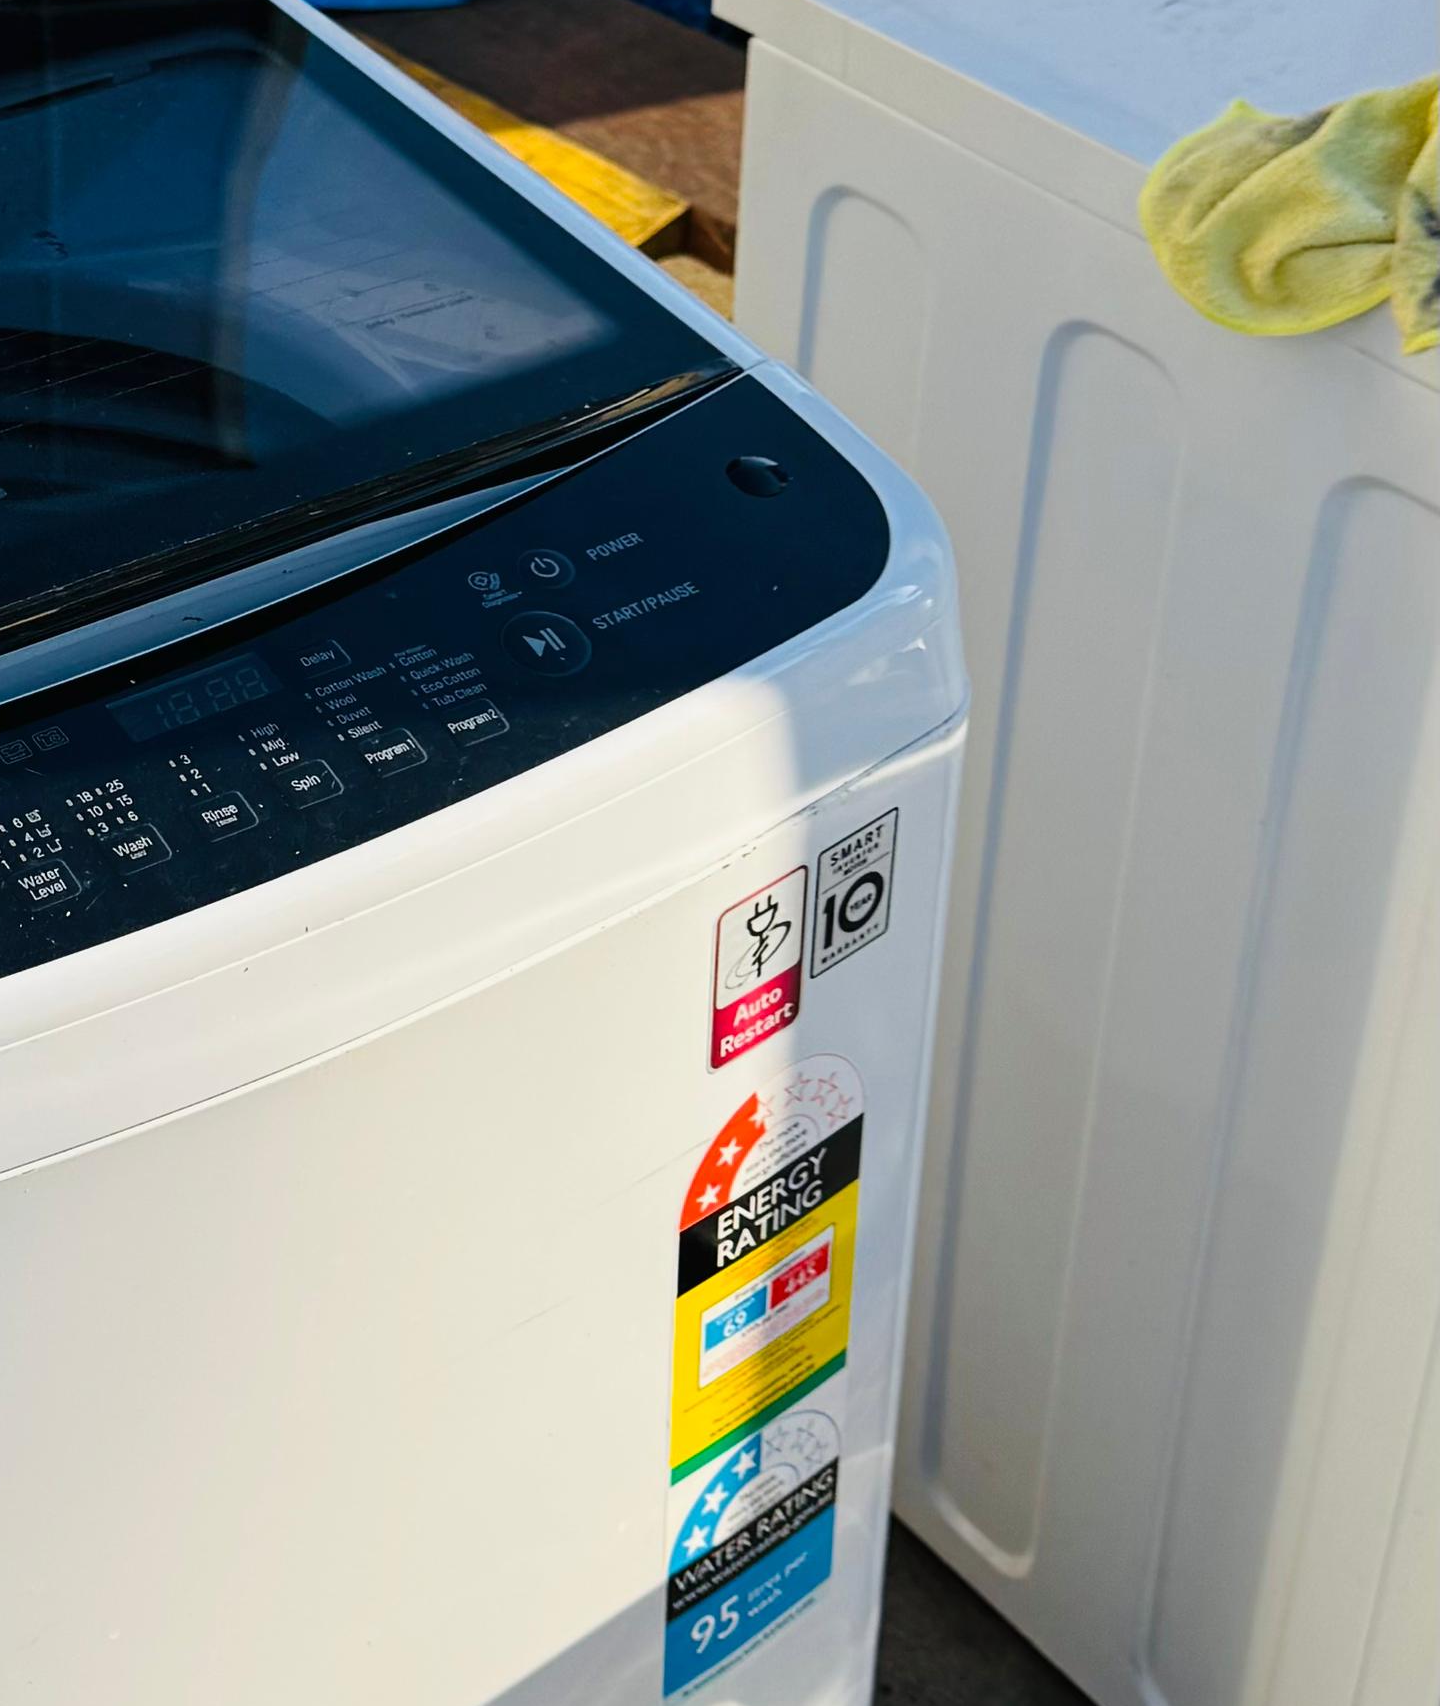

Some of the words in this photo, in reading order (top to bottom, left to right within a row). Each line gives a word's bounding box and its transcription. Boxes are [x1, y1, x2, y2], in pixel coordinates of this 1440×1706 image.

[586, 532, 644, 561] POWER
[592, 581, 700, 630] START/PAUSE
[299, 649, 336, 668] Delay
[398, 647, 438, 667] Cotton
[410, 664, 442, 681] Quick
[441, 651, 475, 669] Wash
[315, 676, 354, 698] Cotton
[354, 665, 388, 684] Wash
[420, 680, 444, 695] Eco
[443, 666, 481, 687] Cotton
[324, 693, 358, 711] Wool
[431, 693, 456, 708] Tub
[454, 681, 488, 699] Clean
[336, 706, 372, 725] Duvet
[447, 710, 490, 735] Program
[487, 708, 499, 720] 2
[249, 721, 280, 739] High
[347, 720, 384, 740] Silent
[179, 754, 192, 765] 3
[271, 751, 300, 768] Low
[364, 742, 408, 765] Program
[189, 768, 203, 780] 2
[290, 773, 321, 792] Spin
[76, 791, 94, 804] 18
[105, 778, 125, 794] 25
[201, 782, 212, 793] 1
[87, 804, 104, 819] 10
[116, 793, 134, 807] 15
[201, 804, 239, 825] Rinse
[12, 817, 24, 829] 6
[97, 821, 110, 833] 3
[127, 810, 139, 822] 6
[24, 831, 35, 843] 4
[112, 835, 154, 858] Wash
[830, 823, 886, 867] SMART
[1, 859, 12, 871] 1
[32, 846, 46, 859] 2
[17, 866, 61, 891] Water
[29, 879, 68, 902] Level
[822, 870, 884, 950] 10
[733, 987, 783, 1028] Auto
[720, 1002, 795, 1058] Restart
[717, 1146, 828, 1241] ENERGY
[716, 1178, 824, 1268] RATING
[722, 1309, 748, 1338] 69
[673, 1529, 753, 1592] WATER
[755, 1466, 835, 1539] RATING
[689, 1594, 740, 1654] 95
